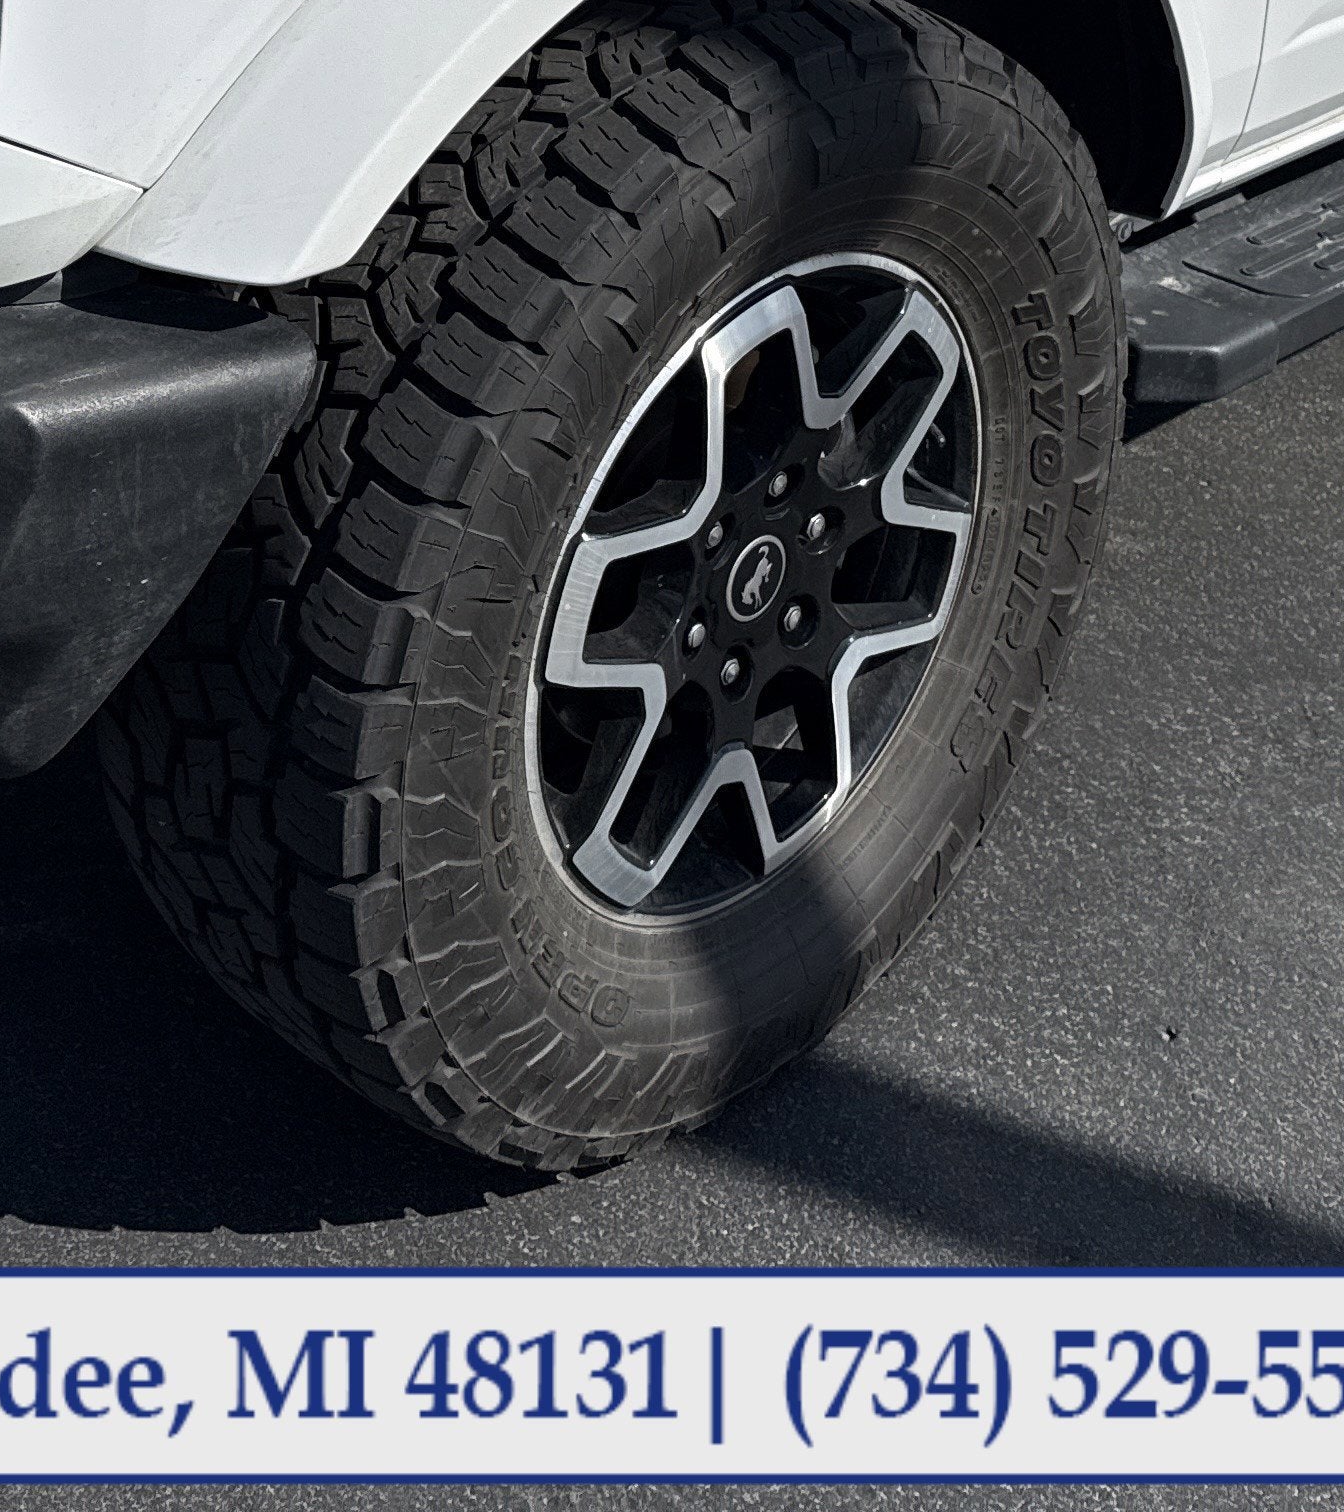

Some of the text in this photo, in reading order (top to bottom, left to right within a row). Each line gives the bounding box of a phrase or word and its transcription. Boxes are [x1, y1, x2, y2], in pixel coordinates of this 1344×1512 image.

[950, 291, 1065, 774] TOYO TIRES
[489, 896, 633, 1030] OPEN
